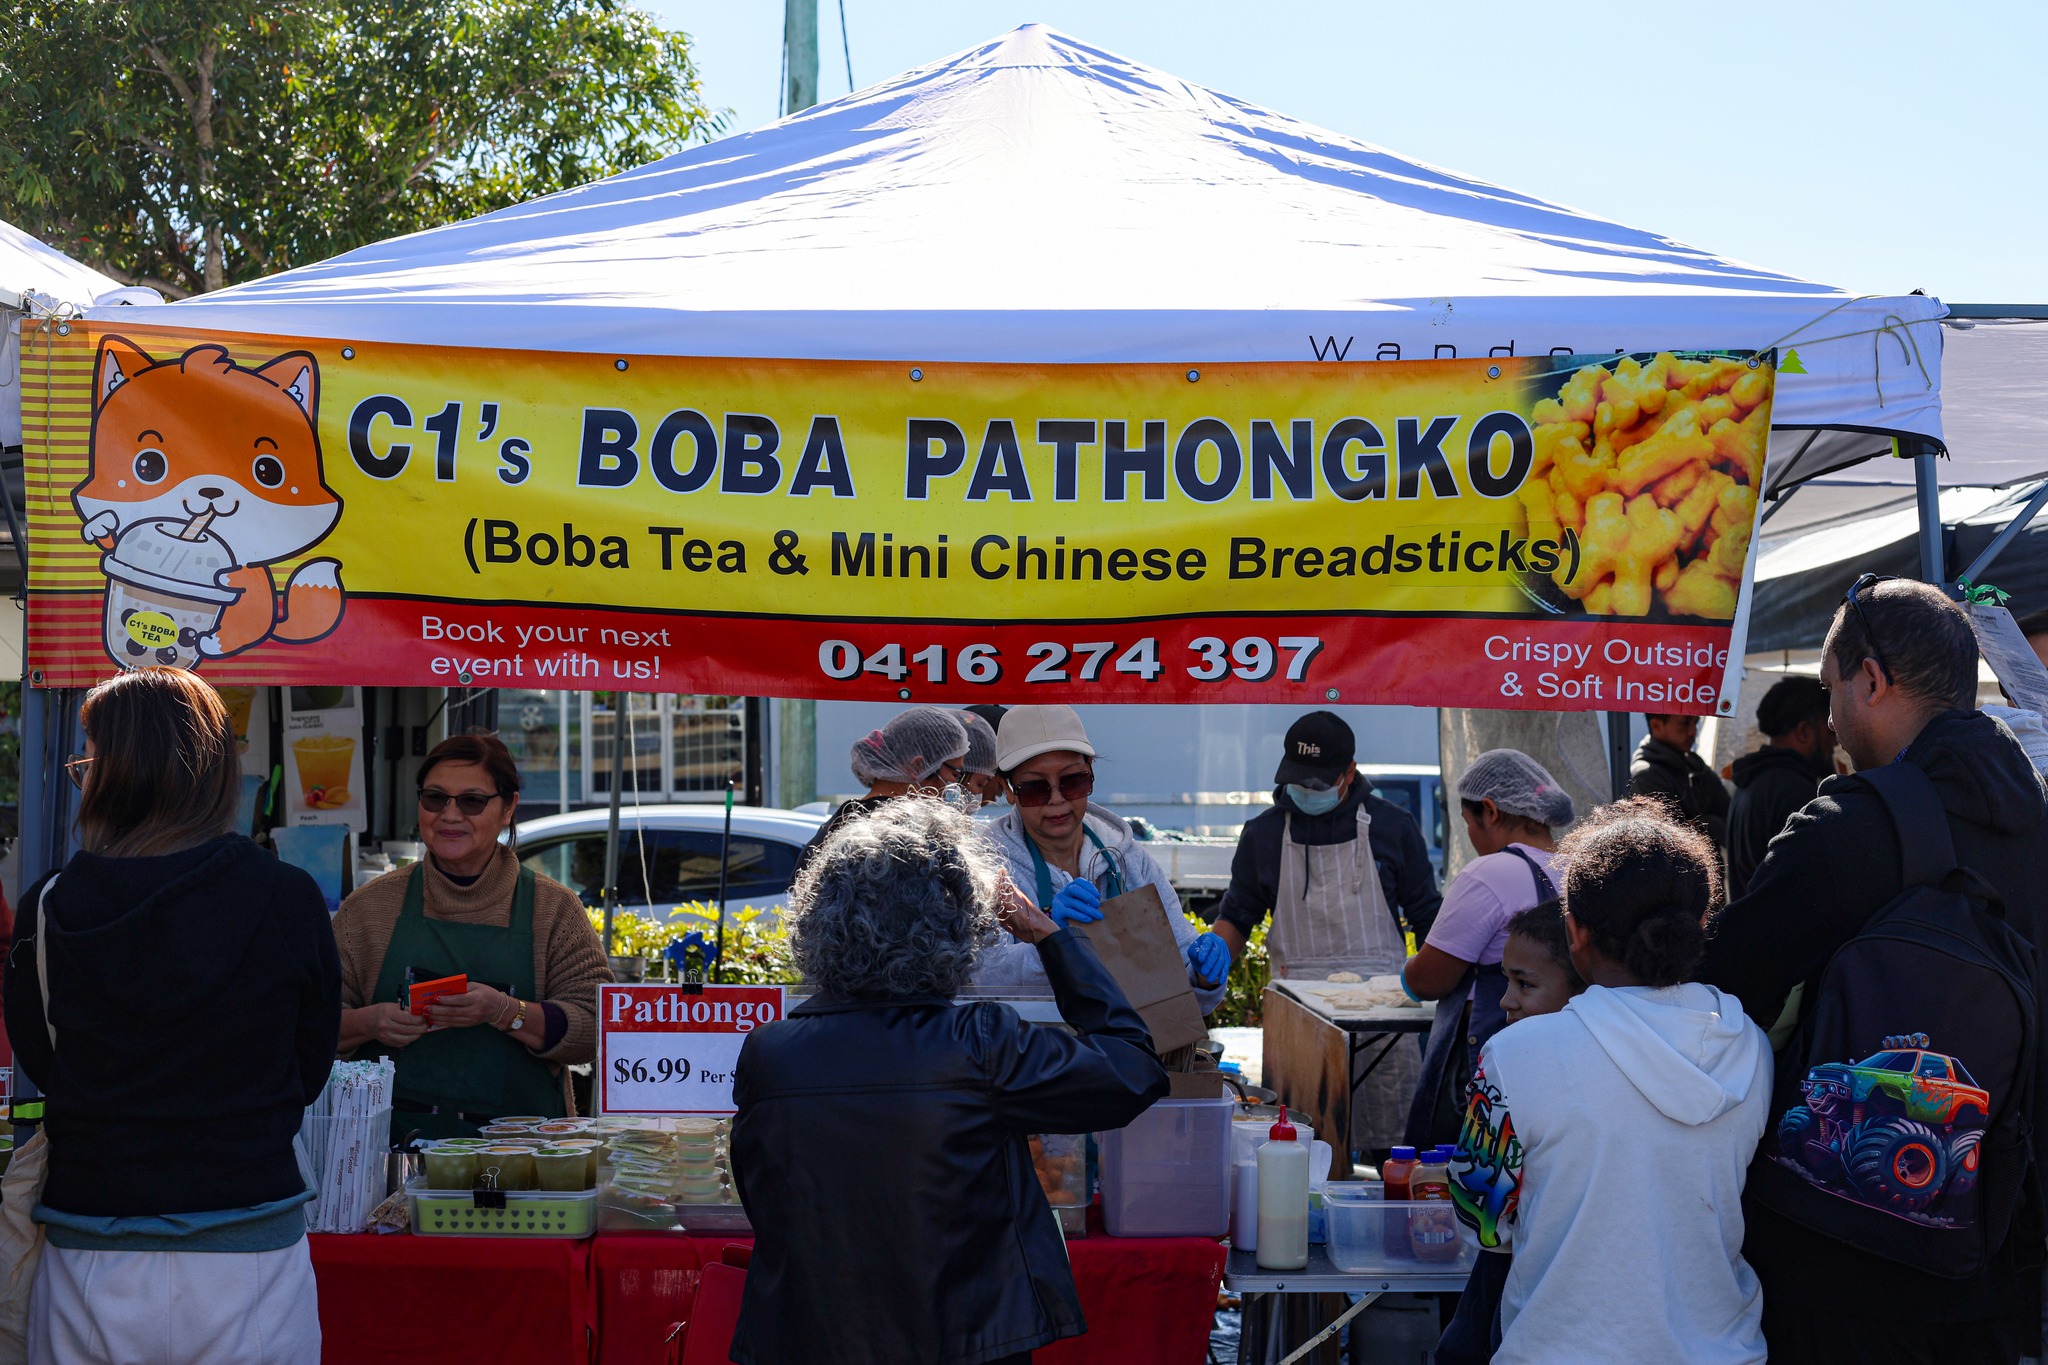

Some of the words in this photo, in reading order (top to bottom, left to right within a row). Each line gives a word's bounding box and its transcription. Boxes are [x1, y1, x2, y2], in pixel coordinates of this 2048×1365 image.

[576, 406, 858, 499] BOBA
[904, 410, 1534, 504] PATHONGKO
[463, 518, 630, 574] (Boba
[647, 526, 747, 574] Tea
[767, 529, 809, 576] &
[830, 531, 949, 579] Mini
[970, 533, 1208, 581] Chinese
[1228, 526, 1582, 586] Breadsticks)
[129, 619, 148, 630] C1's
[150, 624, 176, 637] BOBA
[141, 631, 161, 643] TEA
[421, 615, 505, 643] Book
[515, 624, 589, 648] your
[600, 628, 672, 647] next
[430, 653, 524, 677] event
[534, 652, 600, 677] with
[613, 655, 660, 679] us!
[818, 639, 1001, 684] 0416
[1024, 636, 1163, 684] 274
[1186, 636, 1321, 682] 397
[1484, 635, 1592, 669] Crispy
[1603, 638, 1728, 669] Outside
[1500, 671, 1524, 697] &
[1537, 672, 1603, 700] Soft
[1617, 675, 1717, 704] Inside
[1297, 741, 1321, 755] This
[609, 993, 775, 1032] Pathongo
[613, 1057, 691, 1084] $6.99
[700, 1069, 726, 1083] Per
